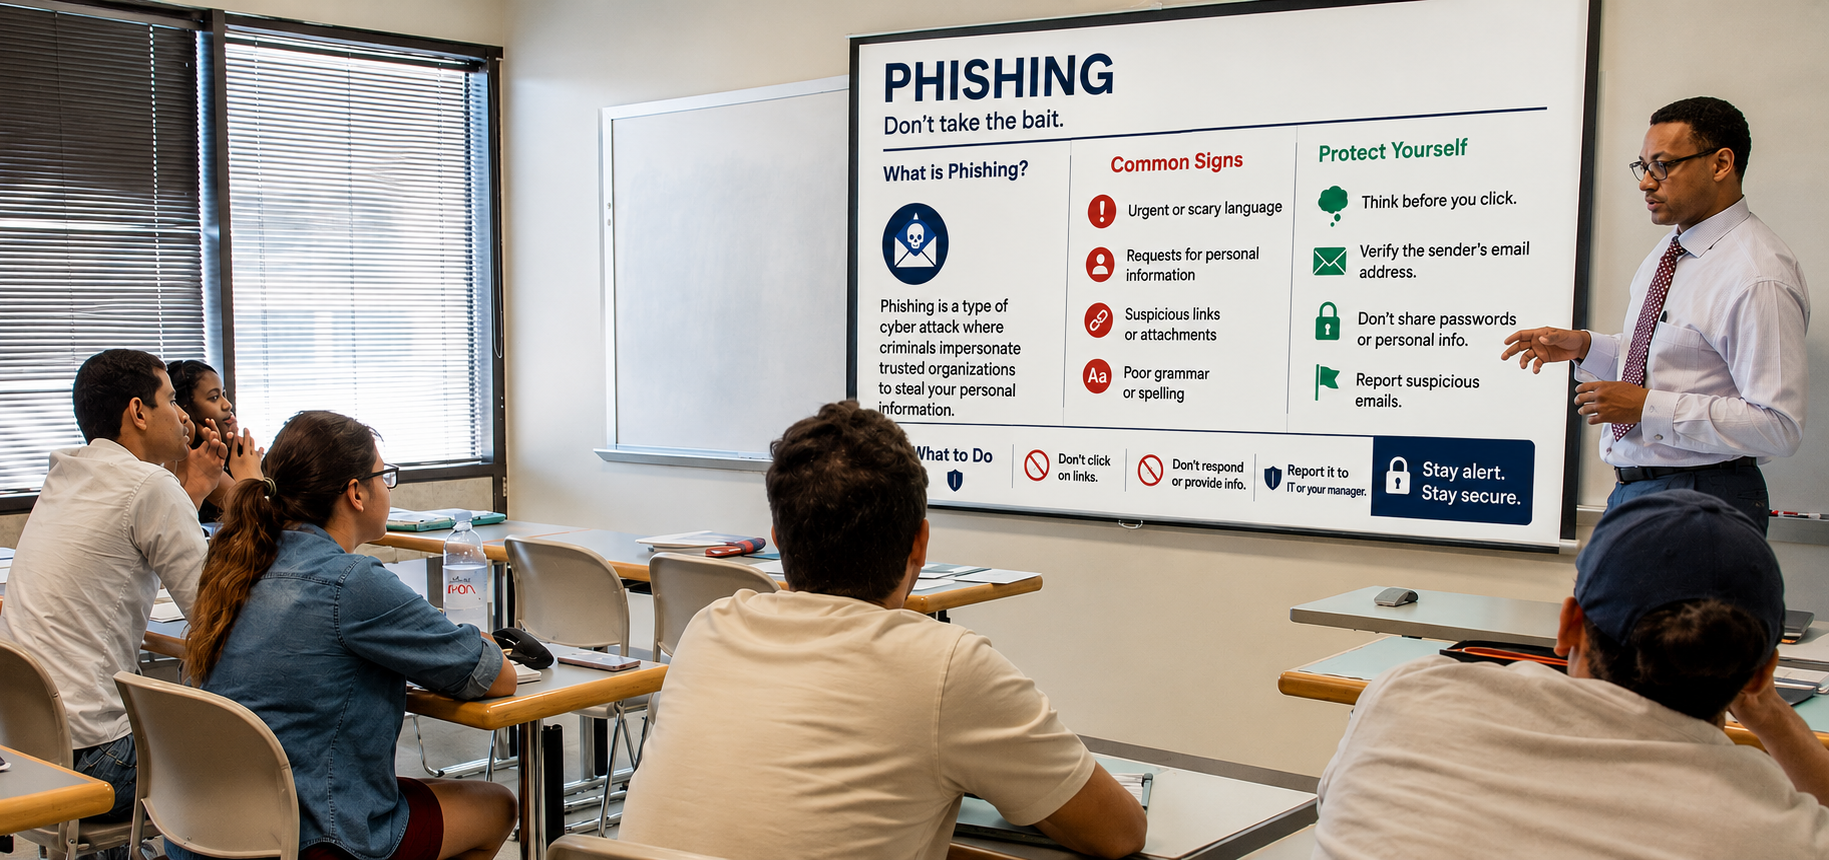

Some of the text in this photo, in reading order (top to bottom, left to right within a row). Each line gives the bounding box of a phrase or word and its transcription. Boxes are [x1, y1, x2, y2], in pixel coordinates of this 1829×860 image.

[885, 53, 1113, 102] PHISHING
[884, 108, 1064, 136] Don't take the bait.
[1318, 137, 1469, 163] Protect Yourself
[882, 159, 1029, 183] What is Phishing?
[1110, 151, 1244, 174] Common Signs
[1128, 200, 1283, 220] Urgent or scary language
[1361, 190, 1517, 211] Think before you click.
[1126, 245, 1260, 265] Requests for personal
[1359, 240, 1530, 261] Verify the sender's email
[1126, 267, 1196, 282] information
[1359, 264, 1417, 279] address.
[880, 297, 1009, 317] Phishing is a type of
[1125, 306, 1221, 324] Suspicious links
[879, 318, 1005, 337] cyber attack where
[1358, 311, 1517, 330] Don't share passwords
[1124, 327, 1217, 342] or attachments
[1357, 332, 1469, 350] or personal info.
[879, 340, 1022, 358] criminals impersonate
[878, 360, 1016, 379] trusted organizations
[1087, 366, 1108, 385] Aa
[1123, 365, 1211, 383] Poor grammar
[878, 380, 1016, 400] to steal your personal
[1356, 372, 1480, 392] Report suspicious
[1122, 386, 1185, 404] or spelling
[1355, 393, 1402, 409] emails.
[878, 400, 956, 417] information.
[913, 445, 994, 464] What to Do
[1058, 452, 1111, 467] Don't click
[1057, 469, 1099, 483] on links.
[1172, 458, 1244, 475] Don't respond
[1287, 463, 1350, 480] Report it to
[1422, 461, 1505, 482] Stay alert.
[1171, 476, 1247, 491] or provide info.
[1286, 481, 1367, 499] IT or your manager.
[1421, 484, 1521, 506] Stay secure.
